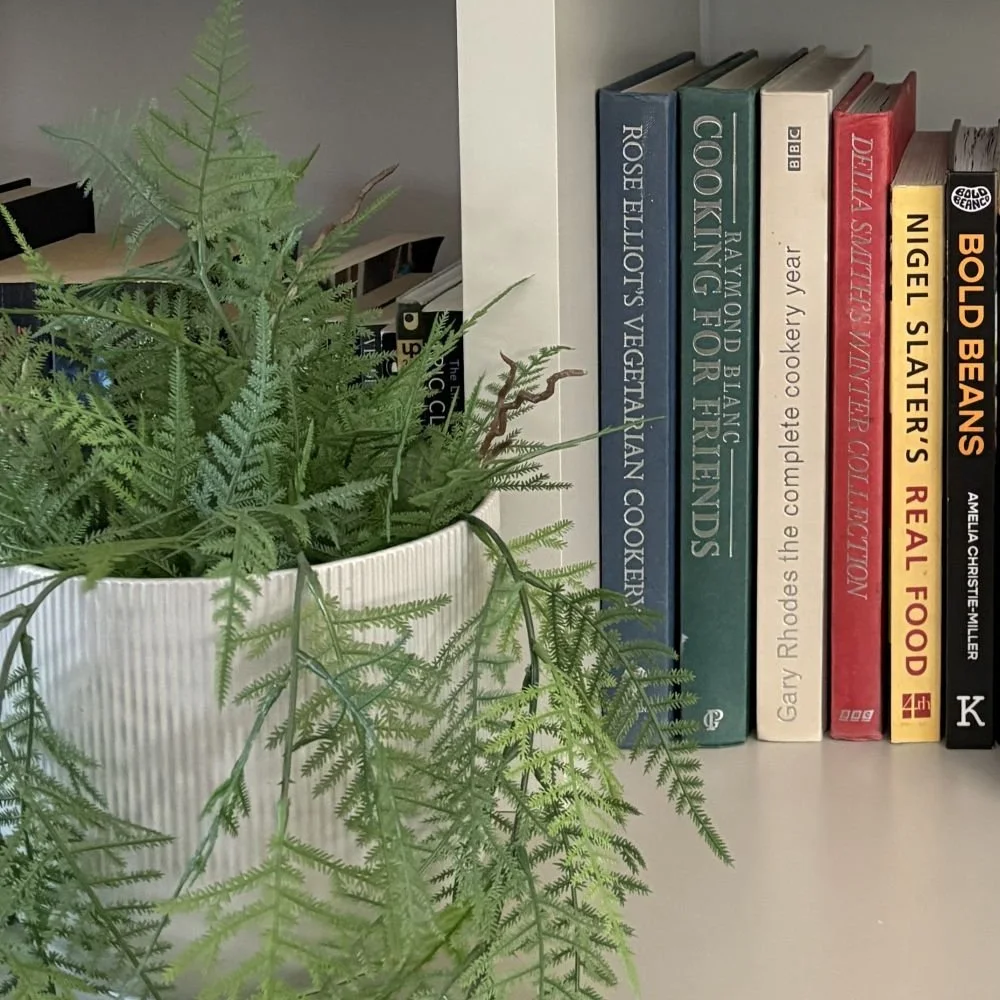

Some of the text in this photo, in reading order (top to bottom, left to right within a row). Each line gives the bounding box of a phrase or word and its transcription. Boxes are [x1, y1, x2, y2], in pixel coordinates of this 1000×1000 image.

[788, 126, 802, 172] BBC
[622, 124, 645, 611] ROSE ELLIOT'S VEGETARIAN COOKERY
[691, 115, 723, 558] COOKING FOR FRIENDS
[723, 231, 742, 443] RAYMOND BLANC
[777, 246, 805, 722] Gary Rhodes the complete cookery year
[846, 133, 873, 599] DELIA SMITH'S WINTER COLLECTION
[905, 214, 929, 676] NIGEL SLATER'S REAL FOOD
[958, 234, 985, 455] BOLD BEANS
[956, 696, 986, 727] K
[967, 491, 978, 660] AMELIA CHRISTIE-MILLER
